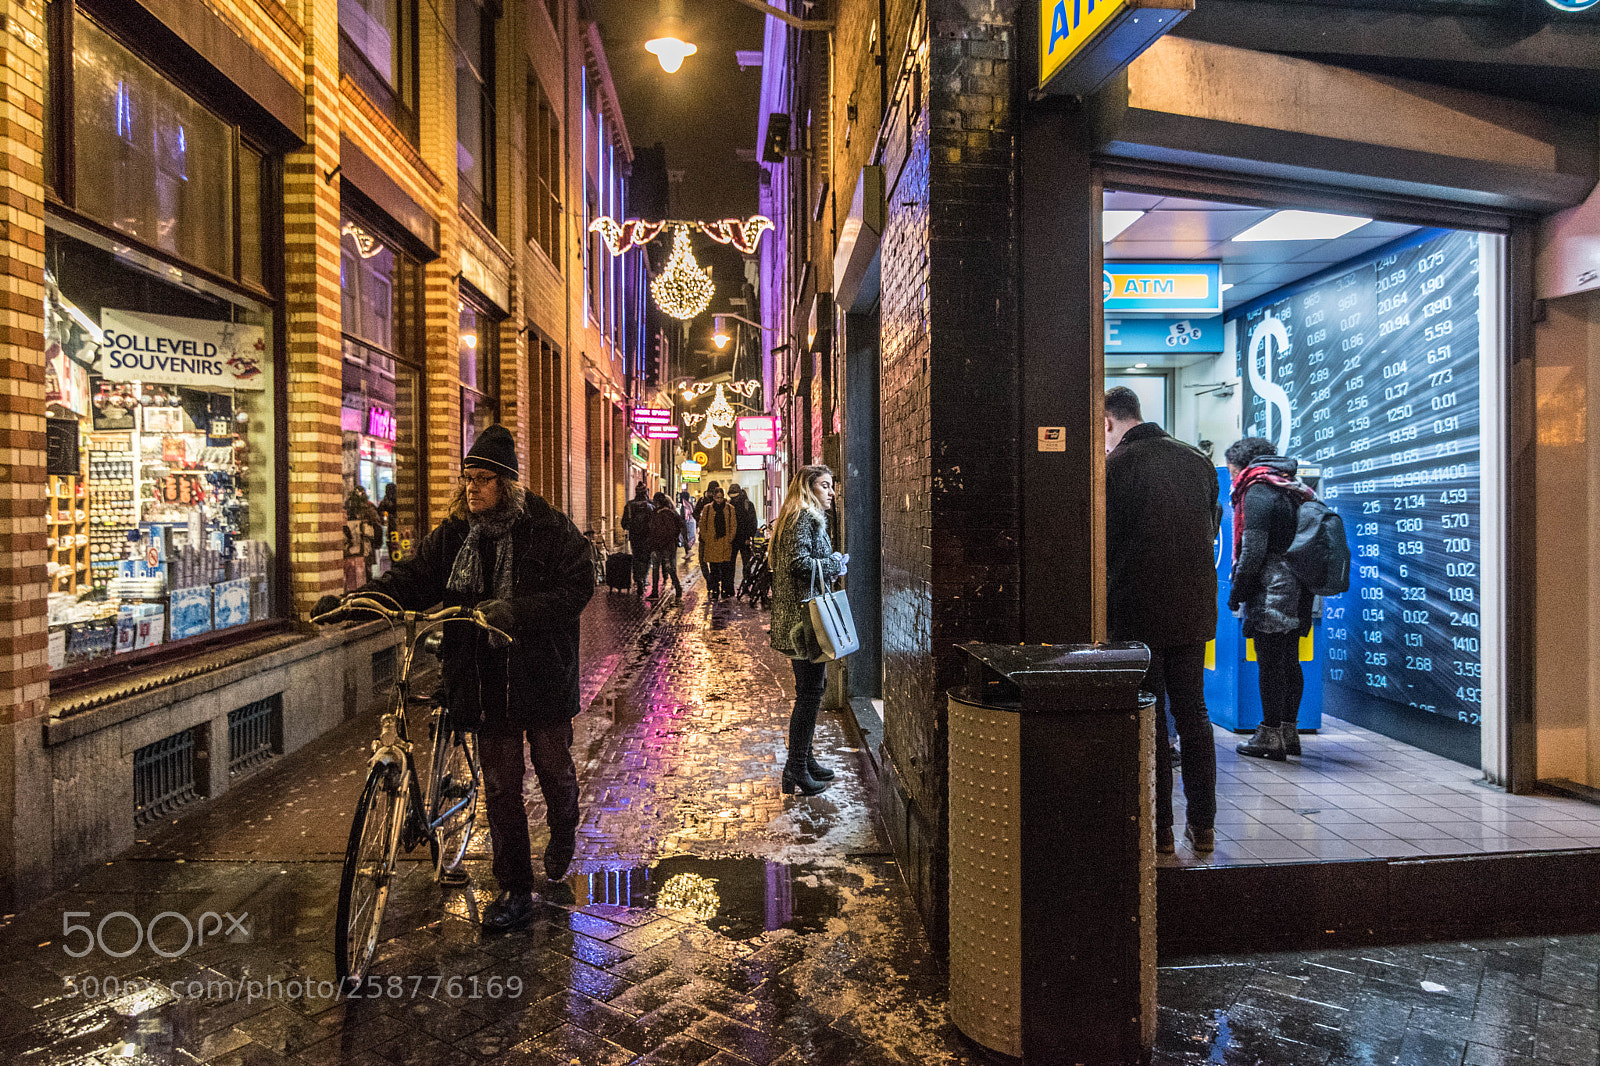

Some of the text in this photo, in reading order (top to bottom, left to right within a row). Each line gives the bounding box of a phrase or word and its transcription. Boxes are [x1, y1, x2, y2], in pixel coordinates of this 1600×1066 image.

[1419, 250, 1445, 273] 0.75
[1124, 278, 1174, 294] ATM
[1376, 269, 1406, 293] 20.59
[1420, 274, 1445, 296] 1.90
[1378, 291, 1408, 315] 20.64
[1422, 296, 1451, 318] 1390
[1305, 310, 1324, 327] 0.20
[1340, 312, 1361, 331] 0.07
[1379, 313, 1410, 337] 20.94
[1307, 328, 1326, 347] 0.69
[1425, 319, 1453, 341] 5.59
[103, 329, 218, 358] SOLLEVELD
[1342, 332, 1364, 352] 0.86
[1427, 345, 1451, 364] 6.51
[110, 350, 223, 376] SOUVENIRS
[1383, 360, 1408, 380] 0.04
[1310, 367, 1329, 385] 2.89
[1345, 375, 1364, 392] 1.65
[1429, 369, 1453, 388] 7.73
[1311, 387, 1331, 403] 3.88
[1385, 382, 1409, 401] 0.37
[1347, 395, 1369, 413] 2.56
[1431, 392, 1457, 411] 0.01
[1313, 407, 1330, 423] 970
[1386, 404, 1413, 422] 1250
[1348, 416, 1371, 433] 3.59
[1433, 416, 1459, 434] 0.91
[1315, 426, 1334, 442] 0.09
[1388, 426, 1418, 445] 19.59
[1350, 437, 1371, 454] 965
[1316, 446, 1336, 462] 0.54
[1390, 449, 1419, 466] 19.65
[1352, 458, 1373, 474] 0.20
[1353, 479, 1376, 494] 0.69
[1440, 488, 1467, 504] 4.59
[1356, 522, 1379, 536] 2.89
[1395, 517, 1423, 533] 1360
[1441, 513, 1469, 529] 5.70
[1357, 544, 1379, 557] 3.88
[1398, 540, 1424, 555] 8.59
[1443, 538, 1471, 553] 7.00
[1360, 565, 1379, 579] 970
[1446, 562, 1476, 578] 0.02
[1361, 587, 1383, 600] 0.09
[1400, 587, 1426, 601] 3.23
[1447, 587, 1474, 602] 1.09
[1326, 607, 1345, 620] 2.47
[1362, 609, 1384, 622] 0.54
[1403, 610, 1429, 624] 0.02
[1450, 612, 1479, 627] 2.40
[1327, 627, 1347, 640] 3.49
[1363, 630, 1383, 644] 1.48
[1404, 633, 1423, 647] 1.51
[1451, 637, 1479, 652] 1410
[1328, 648, 1347, 661] 0.01
[1364, 651, 1387, 666] 2.65
[1405, 656, 1432, 671] 2.68
[1366, 673, 1387, 688] 3.24
